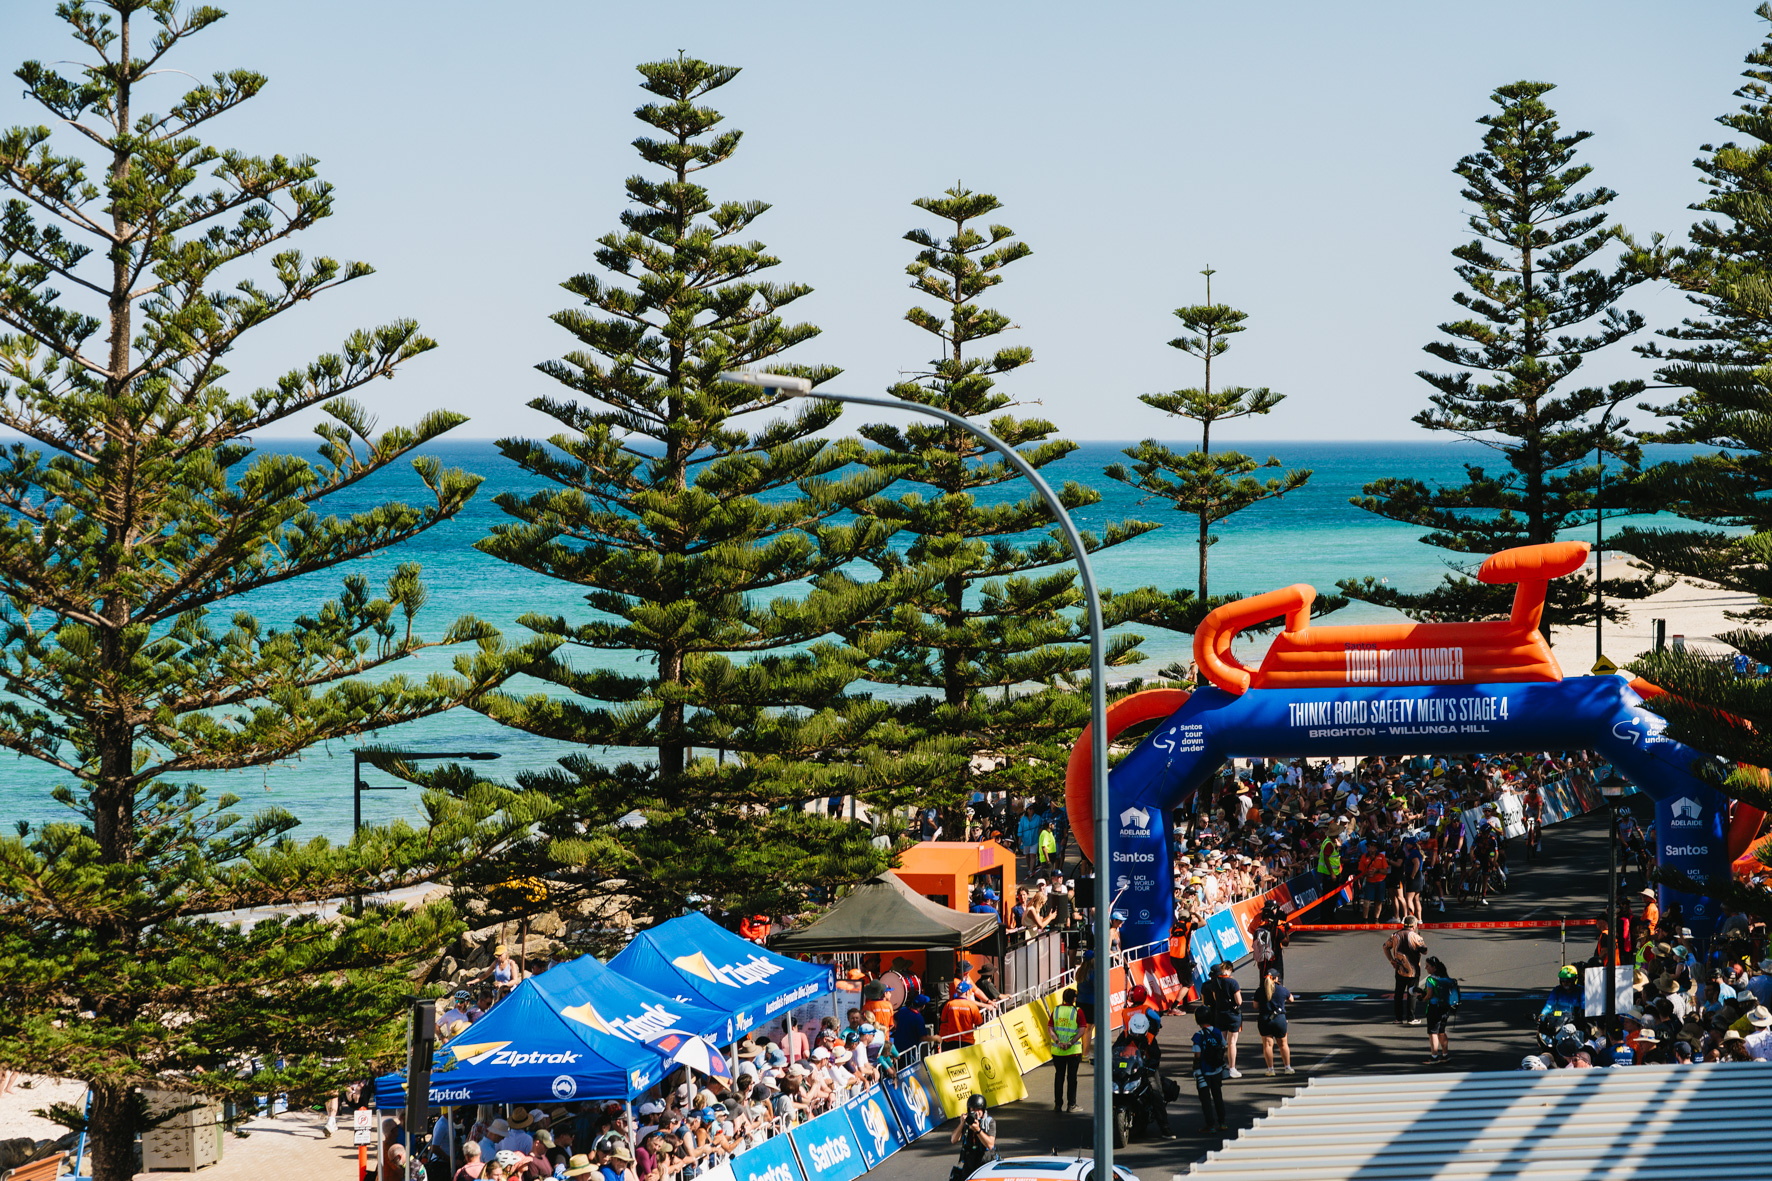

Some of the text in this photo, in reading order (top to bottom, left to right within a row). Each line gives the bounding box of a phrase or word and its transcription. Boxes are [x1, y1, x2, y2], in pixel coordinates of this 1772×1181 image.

[1344, 642, 1377, 650] Santos
[1344, 647, 1464, 683] TOUR DOWN UNDER
[1289, 696, 1509, 727] THINK! ROAD SAFETY MEN'S STAGE 4
[1309, 728, 1376, 738] BRIGHTON
[1388, 725, 1458, 736] WILLUNGA
[1460, 724, 1490, 733] HILL
[1112, 851, 1155, 862] Santos
[1665, 845, 1709, 856] Santos
[1216, 926, 1240, 950] Santos
[718, 953, 785, 986] Ziptrak
[608, 1002, 682, 1041] Ziptrak
[490, 1050, 578, 1067] Ziptrak
[949, 1067, 968, 1077] THINK!
[428, 1088, 470, 1102] Ziptrak
[953, 1083, 968, 1093] ROAD
[956, 1090, 973, 1101] SAFETY
[808, 1135, 851, 1173] Santos
[748, 1162, 794, 1181] tos
